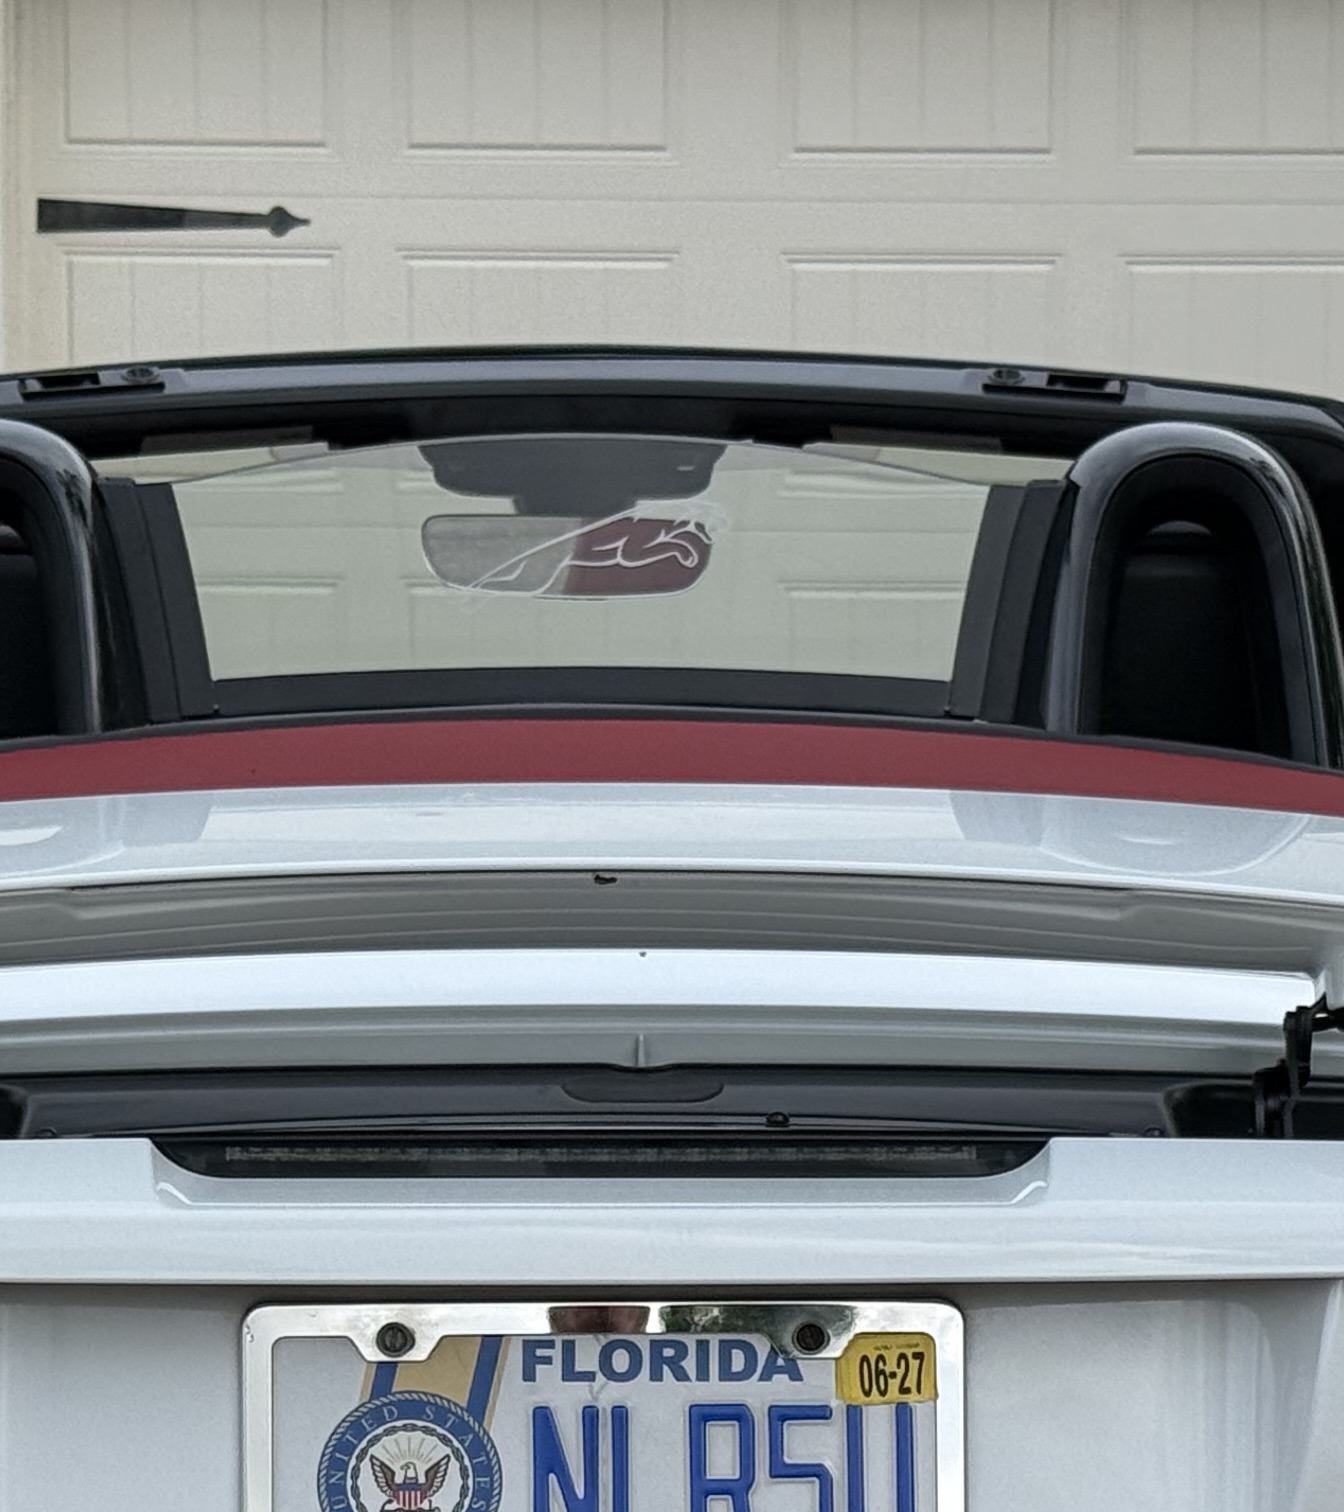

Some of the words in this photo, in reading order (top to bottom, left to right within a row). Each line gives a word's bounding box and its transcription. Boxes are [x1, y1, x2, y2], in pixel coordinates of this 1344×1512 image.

[522, 1338, 804, 1383] FLORIDA
[858, 1351, 926, 1399] 06-27
[328, 1404, 399, 1511] UNITED
[422, 1405, 491, 1512] STATES
